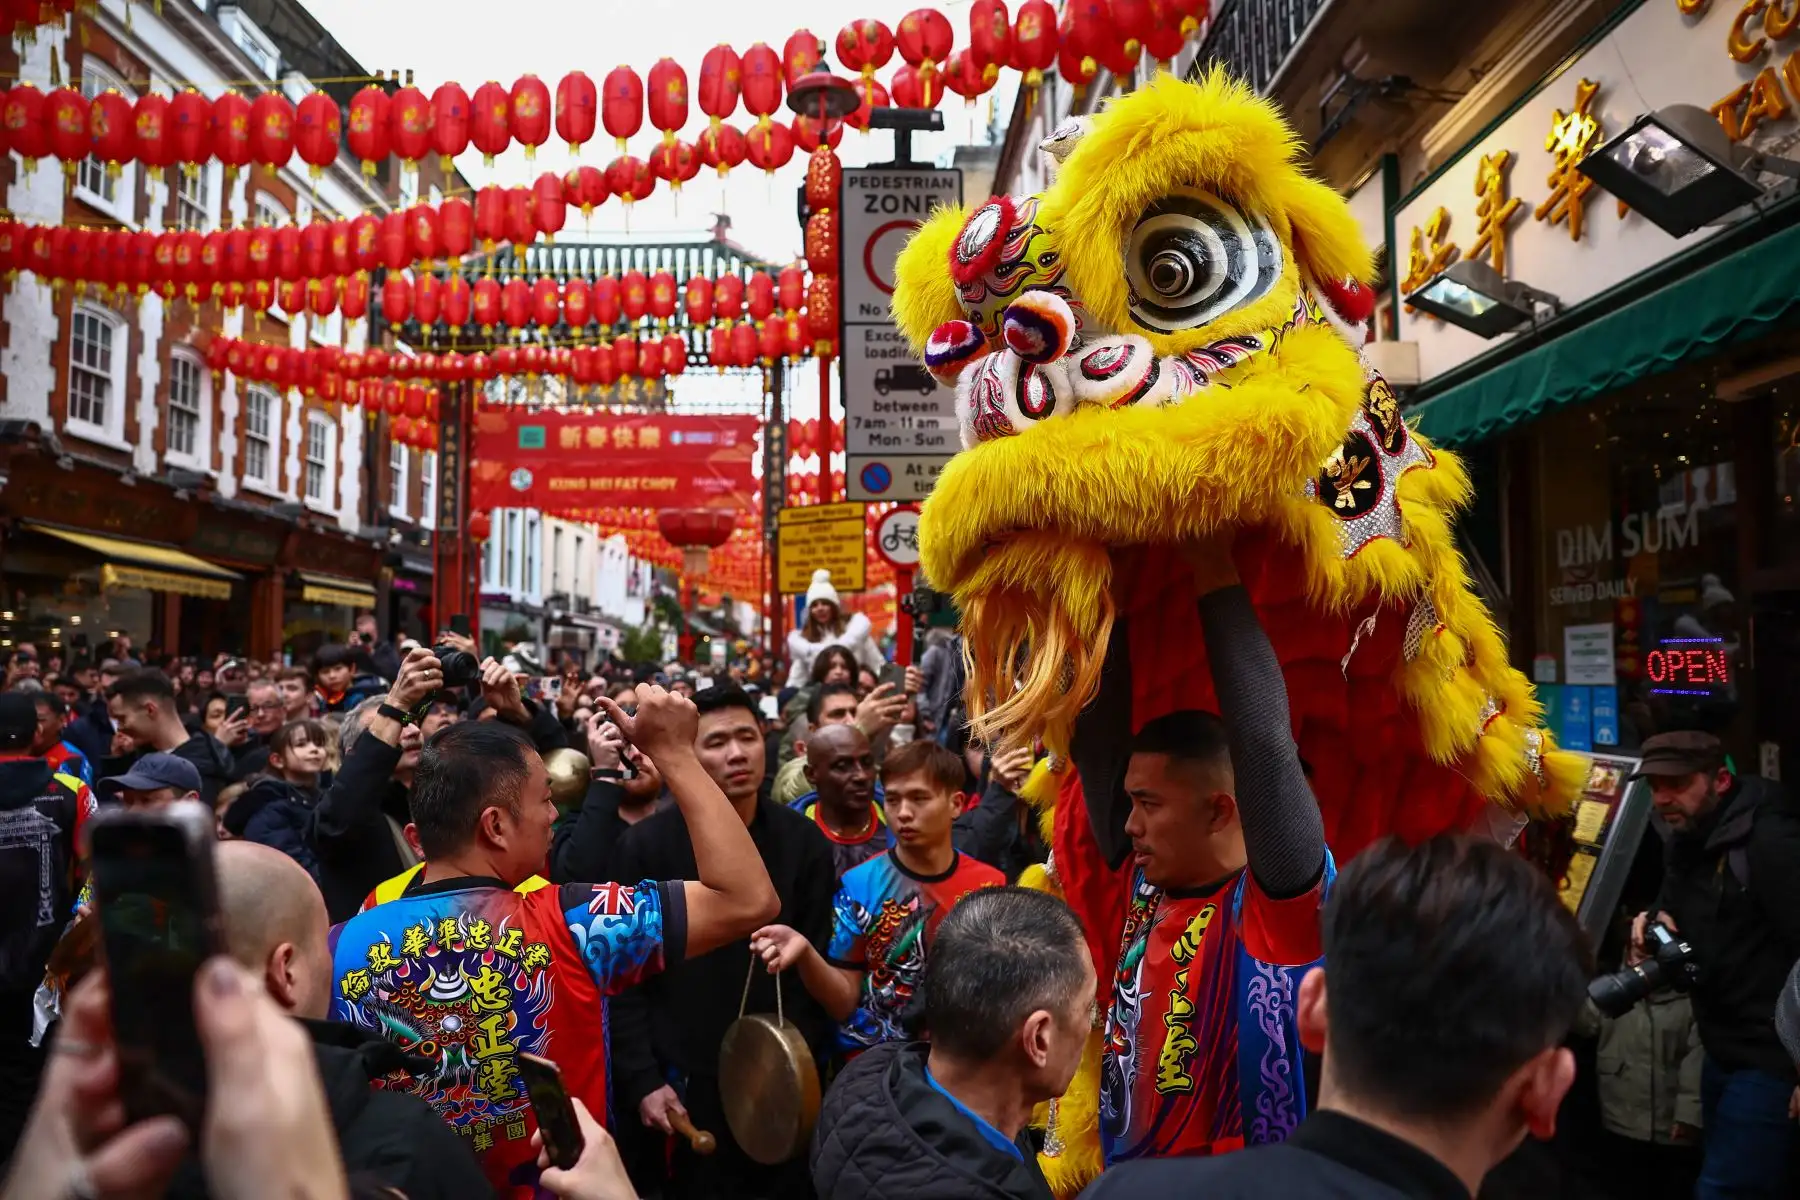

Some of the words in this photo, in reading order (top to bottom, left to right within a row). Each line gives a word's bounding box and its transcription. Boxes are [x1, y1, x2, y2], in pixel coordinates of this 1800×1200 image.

[849, 176, 954, 189] PEDESTRIAN
[863, 194, 939, 214] ZONE
[859, 303, 881, 316] No
[873, 401, 939, 413] between
[853, 416, 887, 429] 7am
[868, 434, 901, 446] Mon
[914, 434, 945, 446] Sun
[905, 463, 923, 476] At
[615, 477, 638, 491] FAT
[1557, 521, 1613, 568] DIM
[1622, 507, 1700, 557] SUM
[1596, 576, 1639, 600] DAILY
[1647, 649, 1728, 683] OPEN
[469, 965, 519, 1102] 忠正堂
